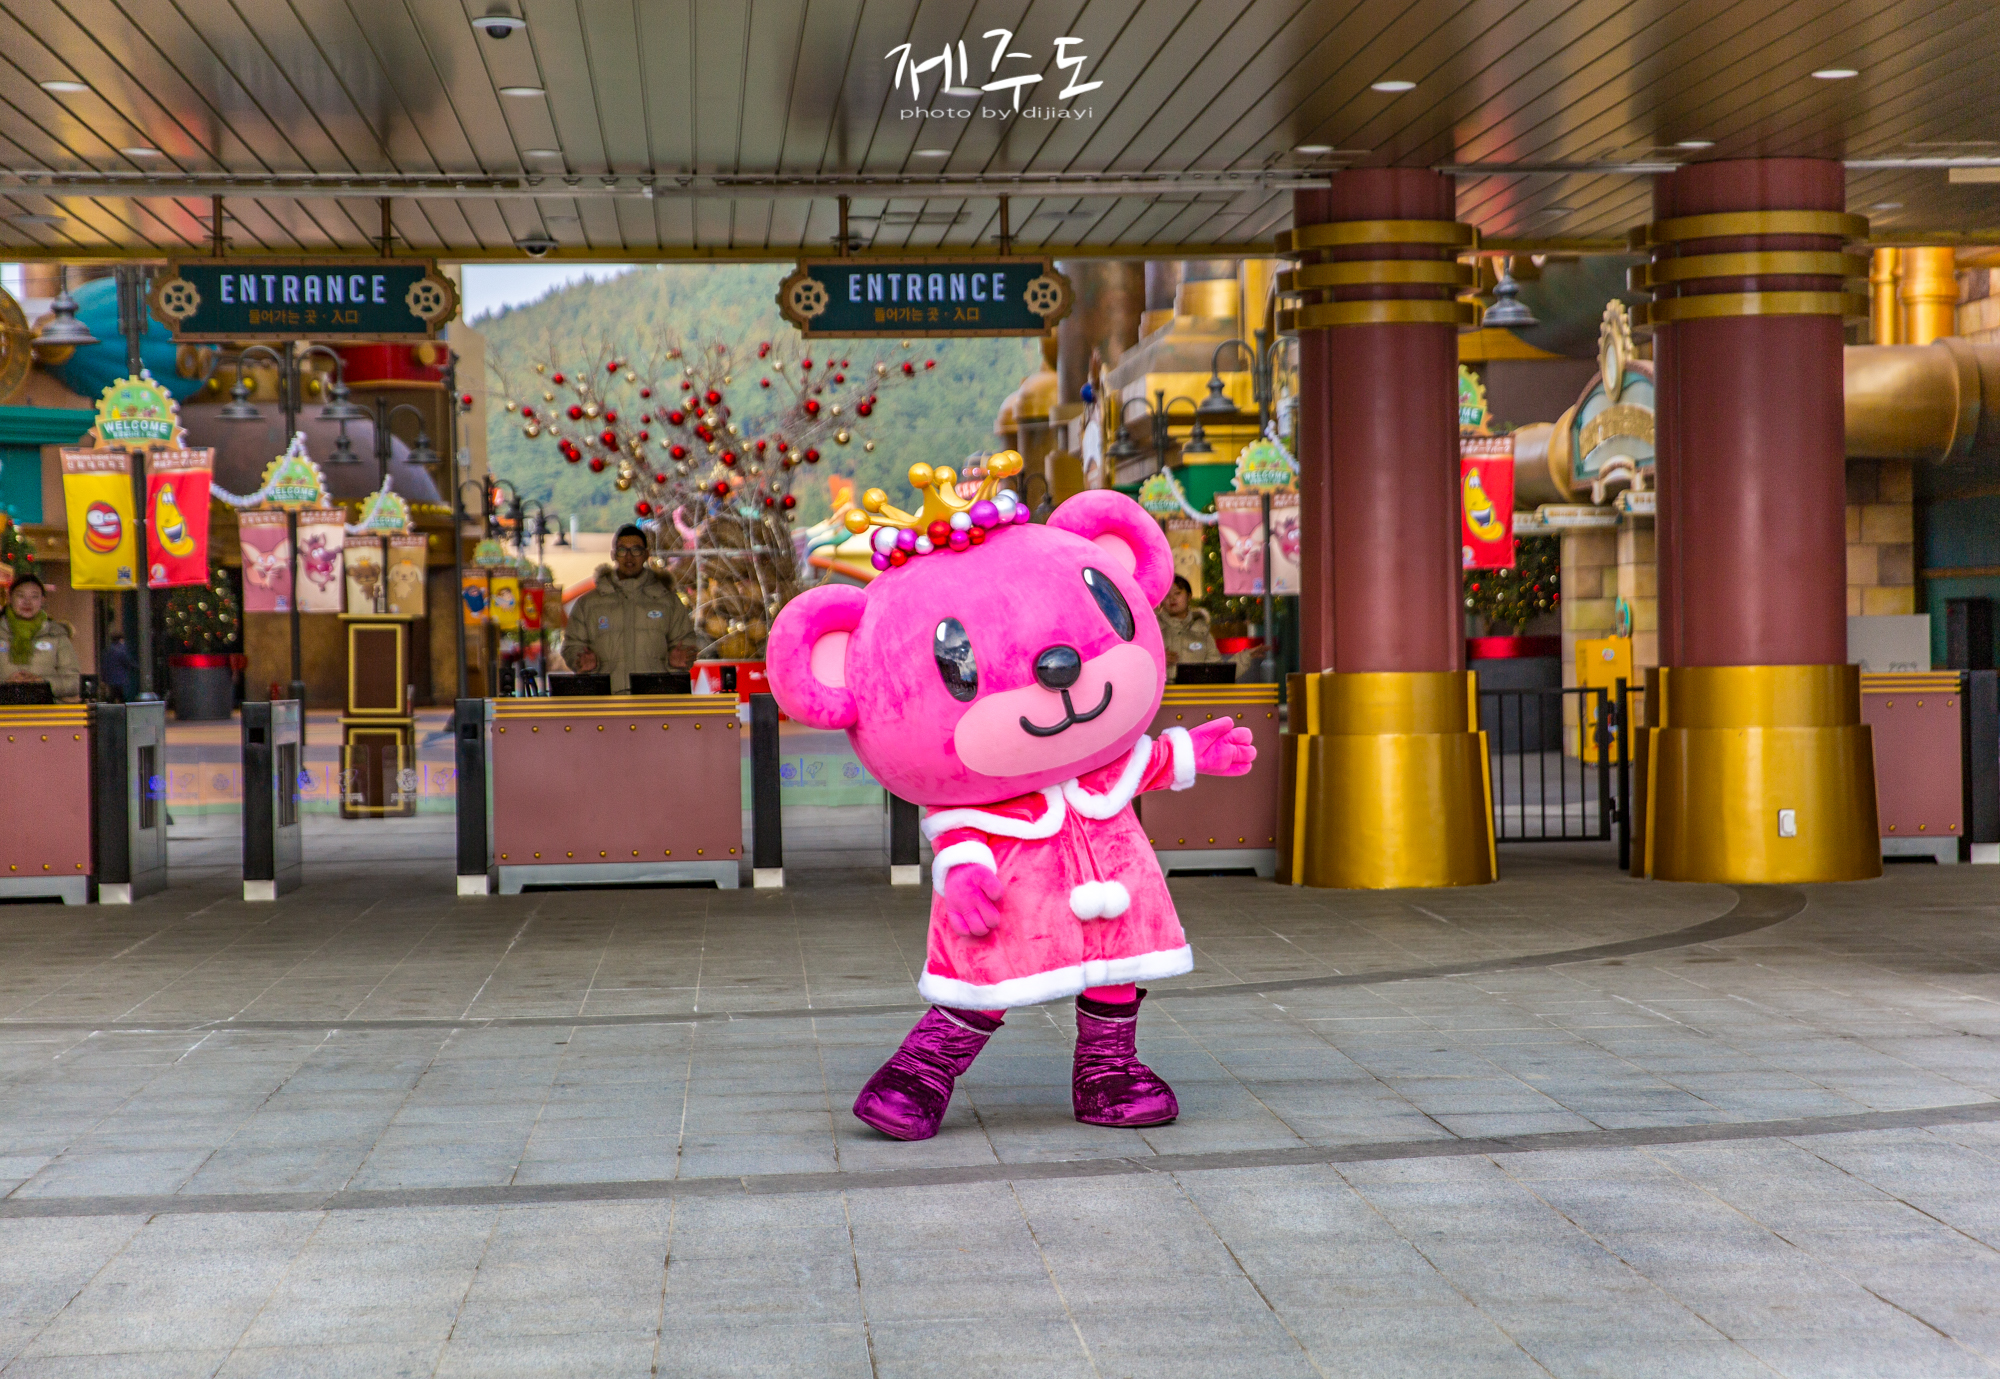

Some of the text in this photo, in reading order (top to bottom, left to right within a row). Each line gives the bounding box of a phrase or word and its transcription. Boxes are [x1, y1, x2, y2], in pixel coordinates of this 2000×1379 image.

[220, 274, 387, 304] ENTRANCE
[848, 272, 1006, 302] ENTRANCE
[103, 420, 169, 436] WELCOME
[1242, 470, 1289, 481] WELCOME
